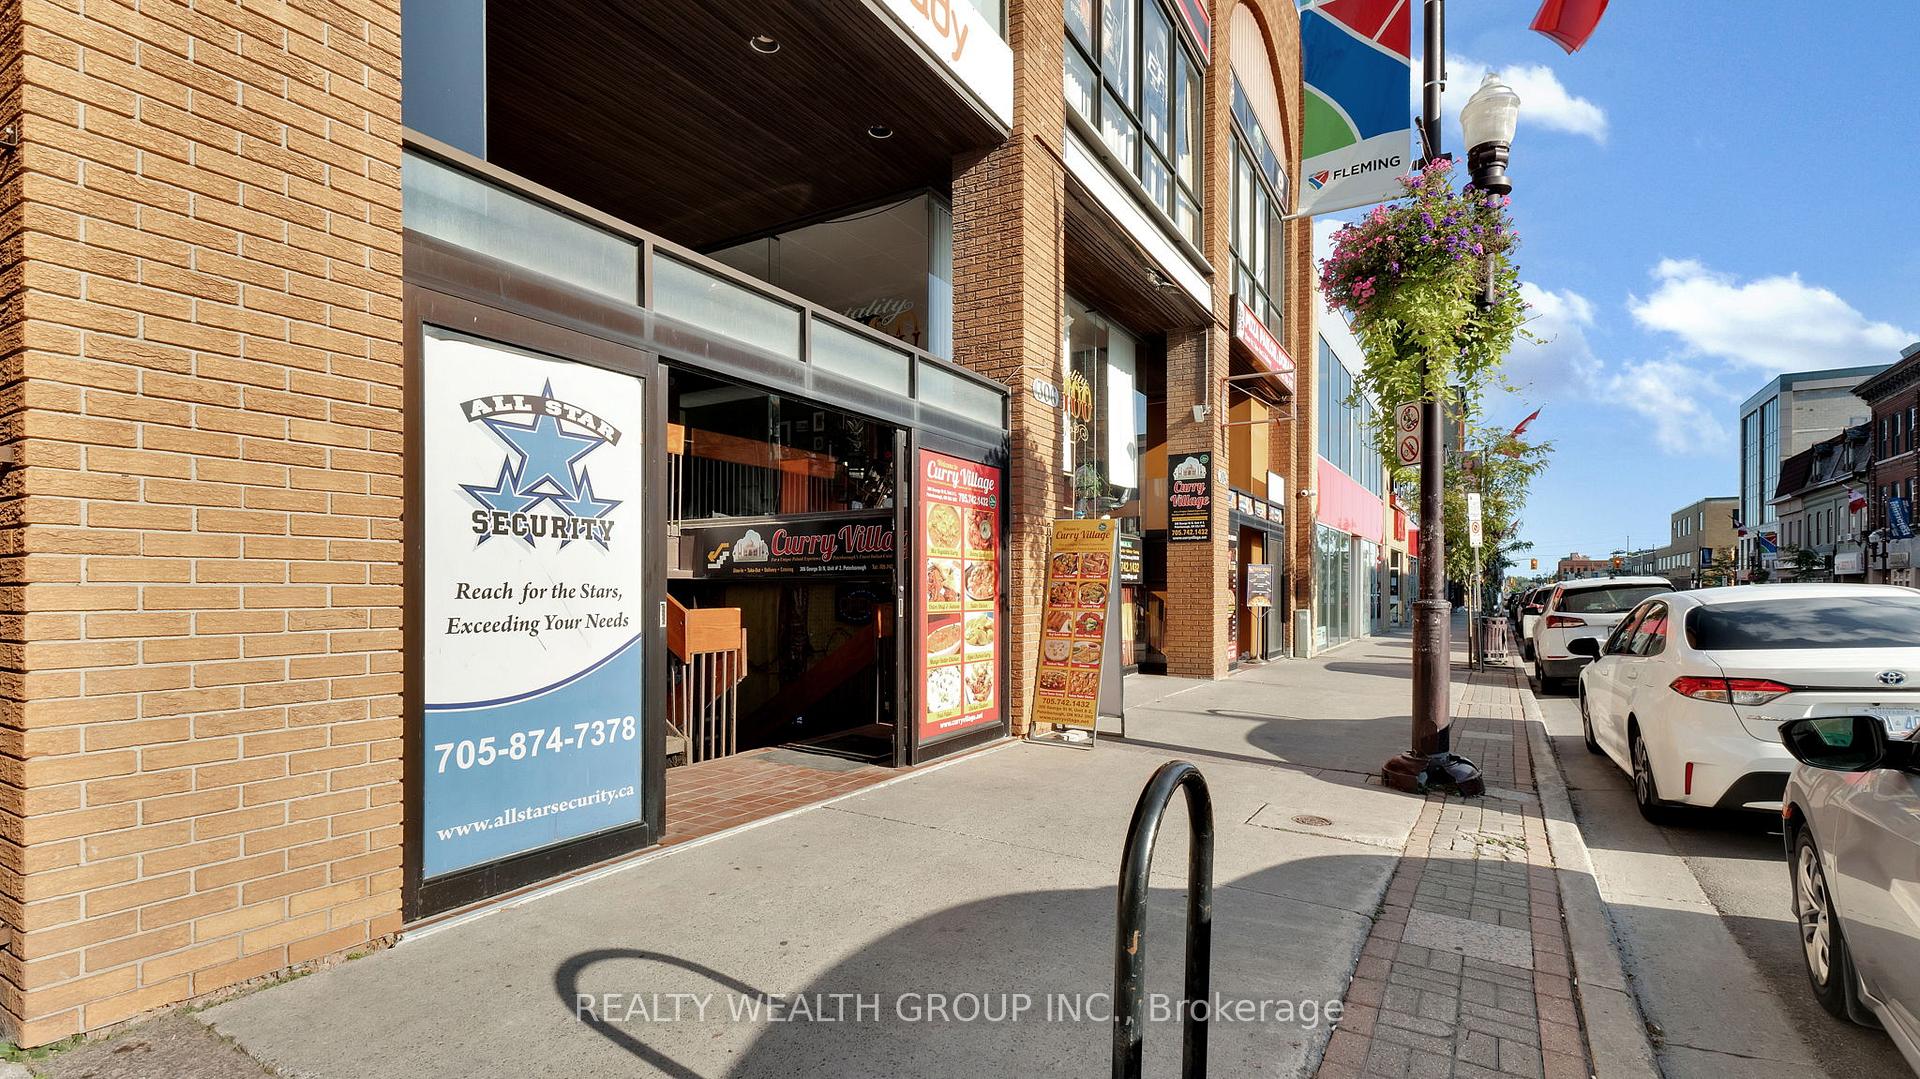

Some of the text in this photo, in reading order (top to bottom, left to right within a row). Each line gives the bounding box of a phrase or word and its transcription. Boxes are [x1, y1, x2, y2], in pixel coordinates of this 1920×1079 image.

[1333, 156, 1401, 180] FLEMING
[470, 395, 616, 442] ALL STAR
[927, 461, 959, 488] Curry
[960, 468, 995, 494] Village
[1173, 480, 1206, 495] Curry
[1169, 494, 1210, 509] Village
[471, 509, 615, 542] SECURITY
[1056, 530, 1111, 541] Curry Village
[771, 524, 894, 562] Curry Villa
[454, 581, 623, 605] Reach for the Stars,
[445, 612, 630, 637] Exceeding Your Needs
[1042, 698, 1090, 708] 705.742.1432
[434, 716, 636, 774] 705-874-7378
[436, 784, 635, 841] www.allstarsecurity.ca
